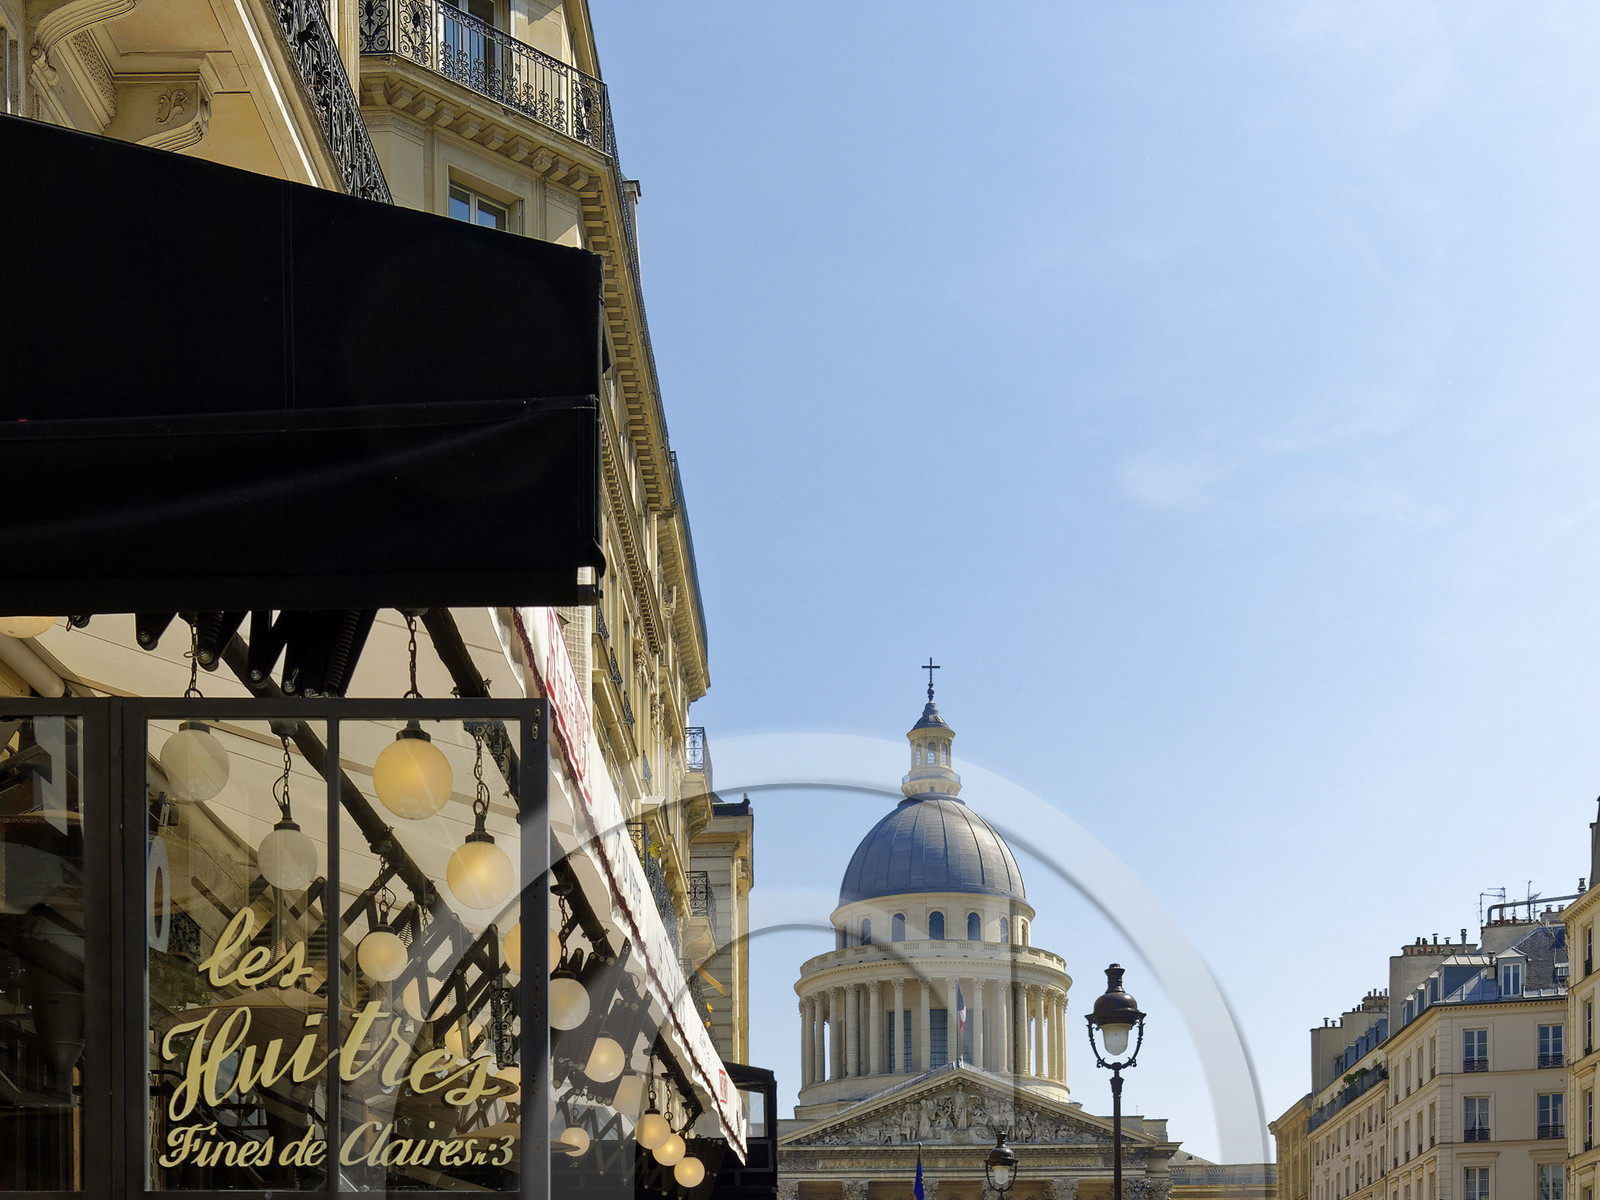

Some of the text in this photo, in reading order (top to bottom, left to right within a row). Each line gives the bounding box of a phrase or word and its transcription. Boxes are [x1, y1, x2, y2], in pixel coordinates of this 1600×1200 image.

[199, 907, 313, 988] les
[162, 1000, 502, 1122] Huitres
[159, 1121, 274, 1168] Fines
[279, 1124, 328, 1168] de
[340, 1121, 480, 1168] Claires
